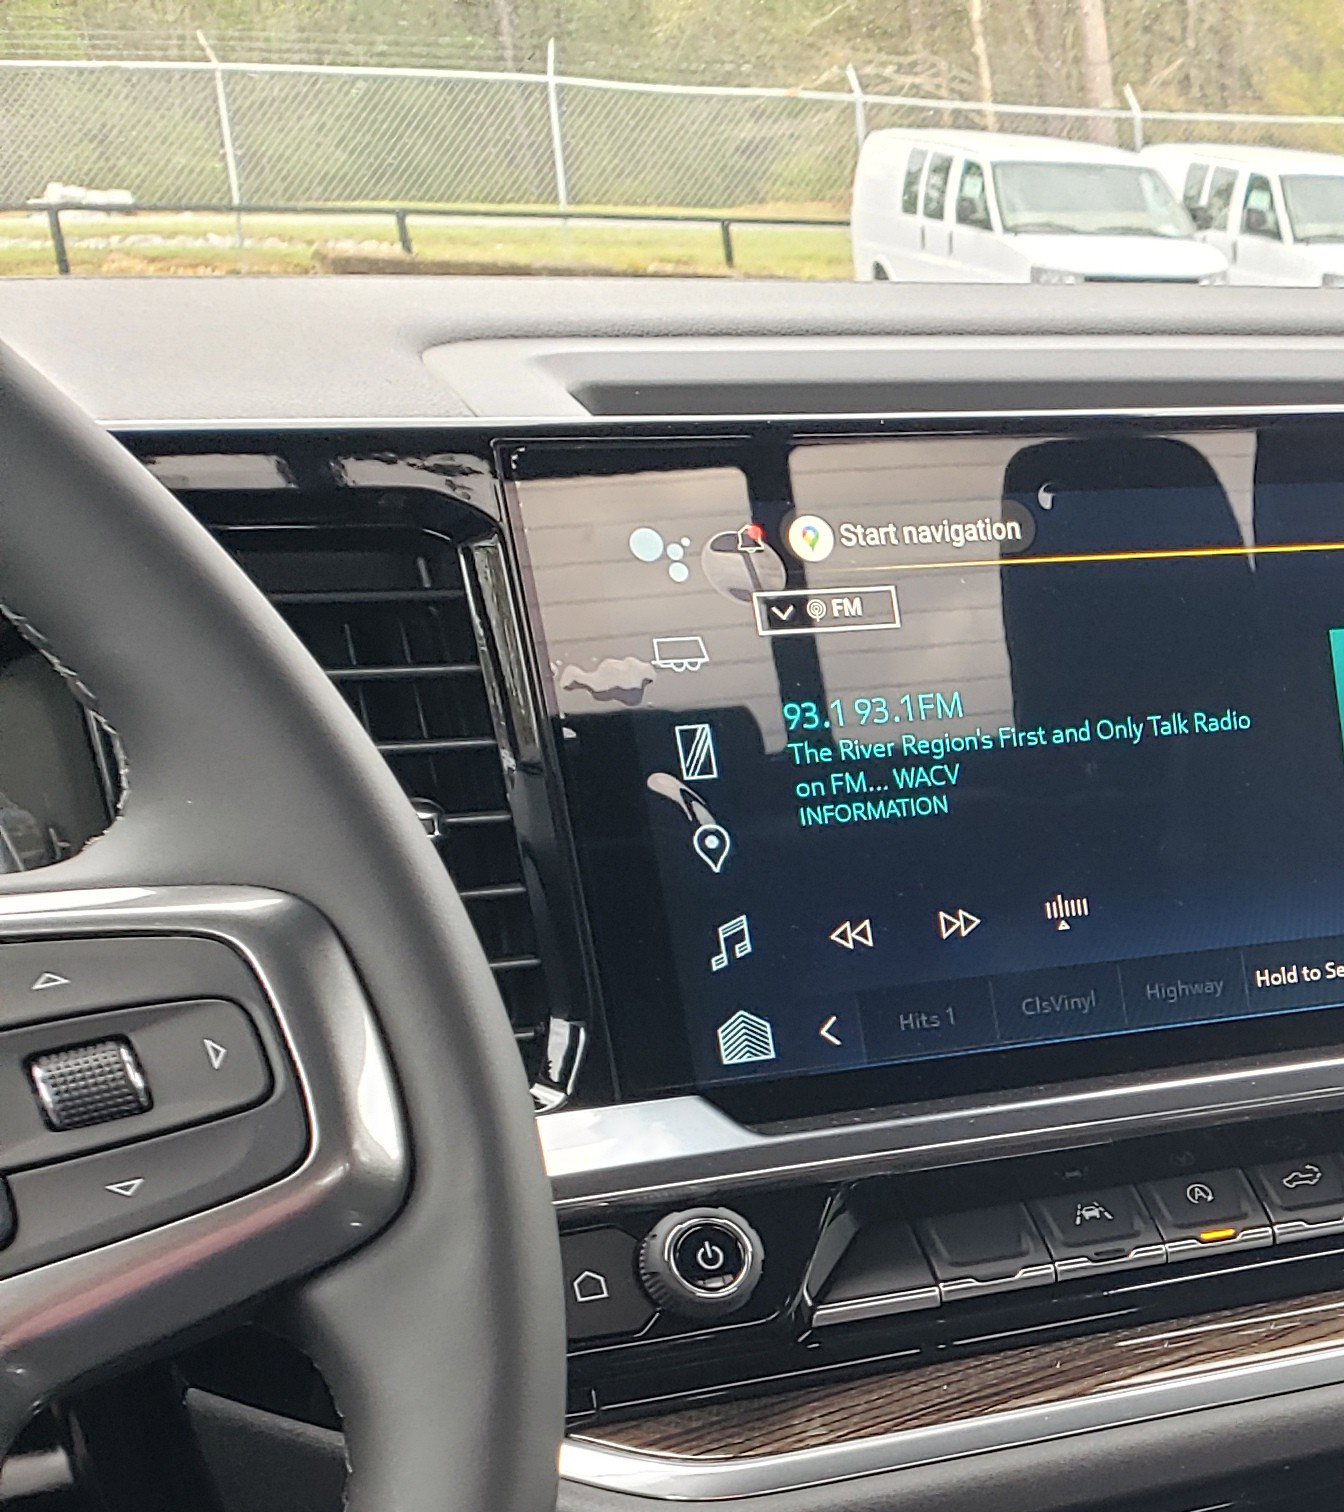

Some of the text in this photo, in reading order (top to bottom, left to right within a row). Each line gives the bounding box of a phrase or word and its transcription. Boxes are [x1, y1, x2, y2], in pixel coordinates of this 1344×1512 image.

[840, 517, 1021, 547] Start navigation
[832, 597, 863, 617] FM
[783, 690, 964, 731] 93.1 93.1FM
[787, 708, 1251, 765] The River Region's First and Only Talk Radio
[796, 763, 960, 798] on FM... WACV
[799, 795, 949, 826] INFORMATION
[1255, 965, 1298, 988] Hold
[1301, 966, 1322, 982] to
[1021, 990, 1097, 1016] ClsVinyl
[1145, 979, 1224, 1003] Highway
[899, 1006, 956, 1031] Hits 1
